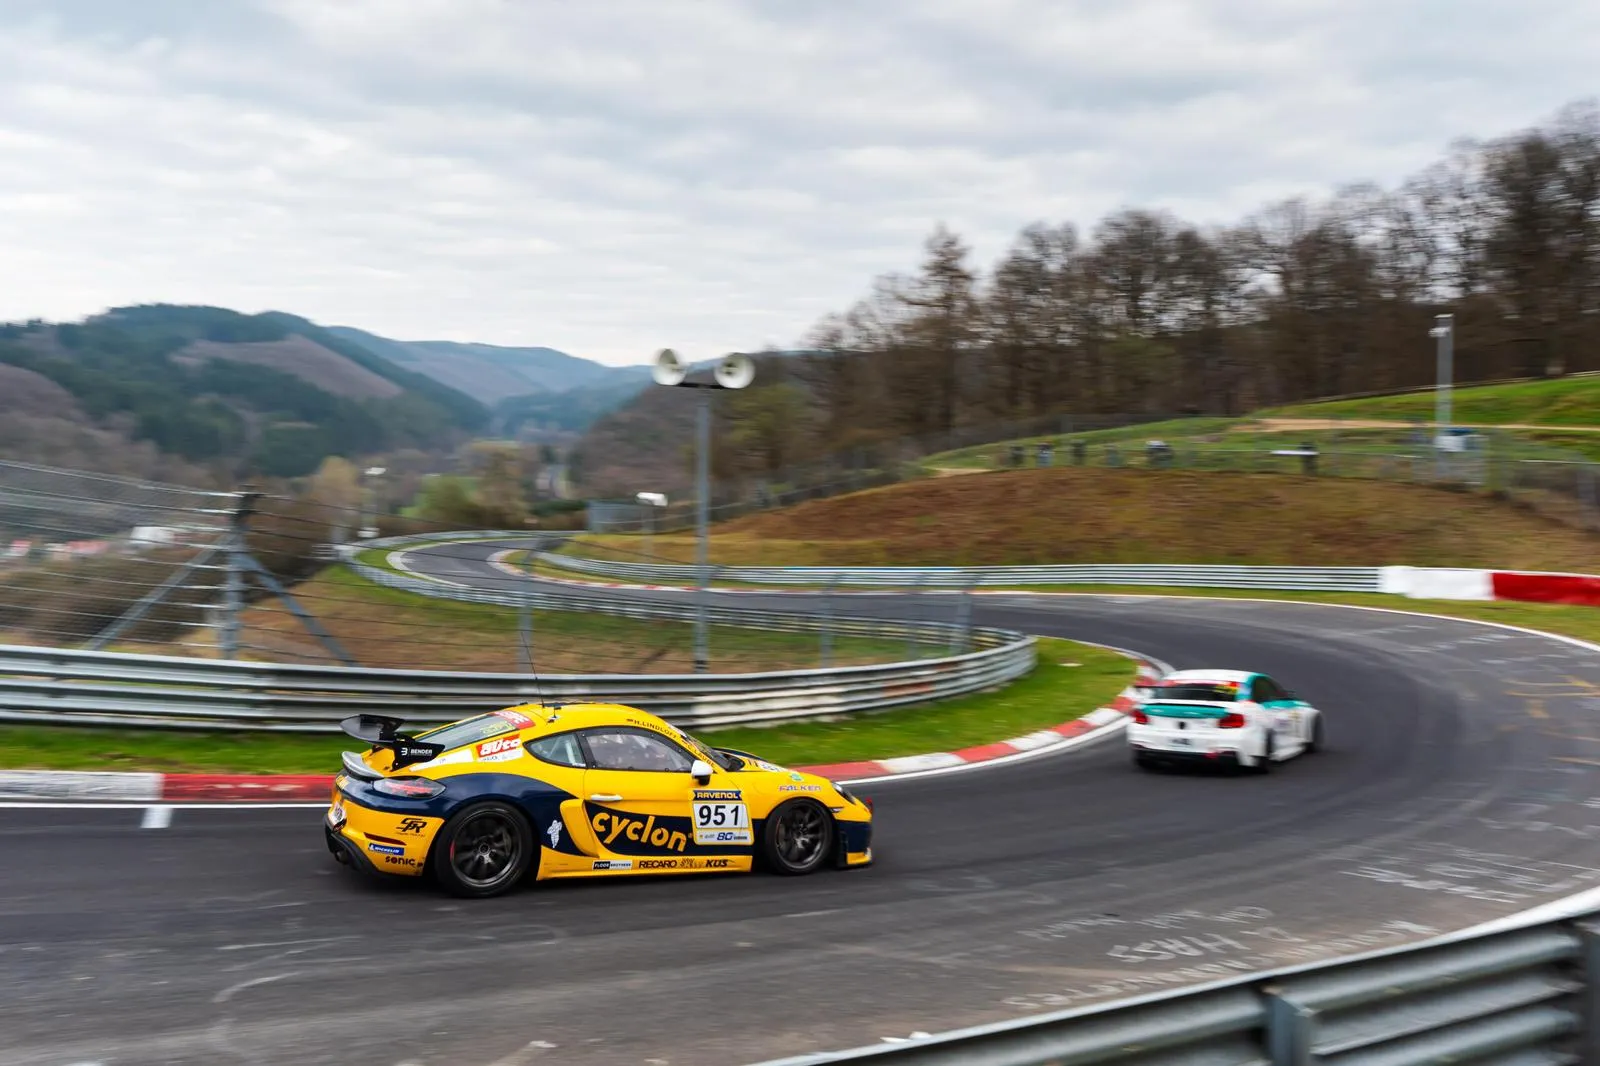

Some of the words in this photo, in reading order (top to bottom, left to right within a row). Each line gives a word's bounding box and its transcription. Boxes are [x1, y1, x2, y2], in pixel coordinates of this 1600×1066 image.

[696, 791, 739, 799] RAVENOL
[699, 805, 739, 826] 951
[592, 812, 687, 852] cyclon
[638, 860, 678, 869] RECARO
